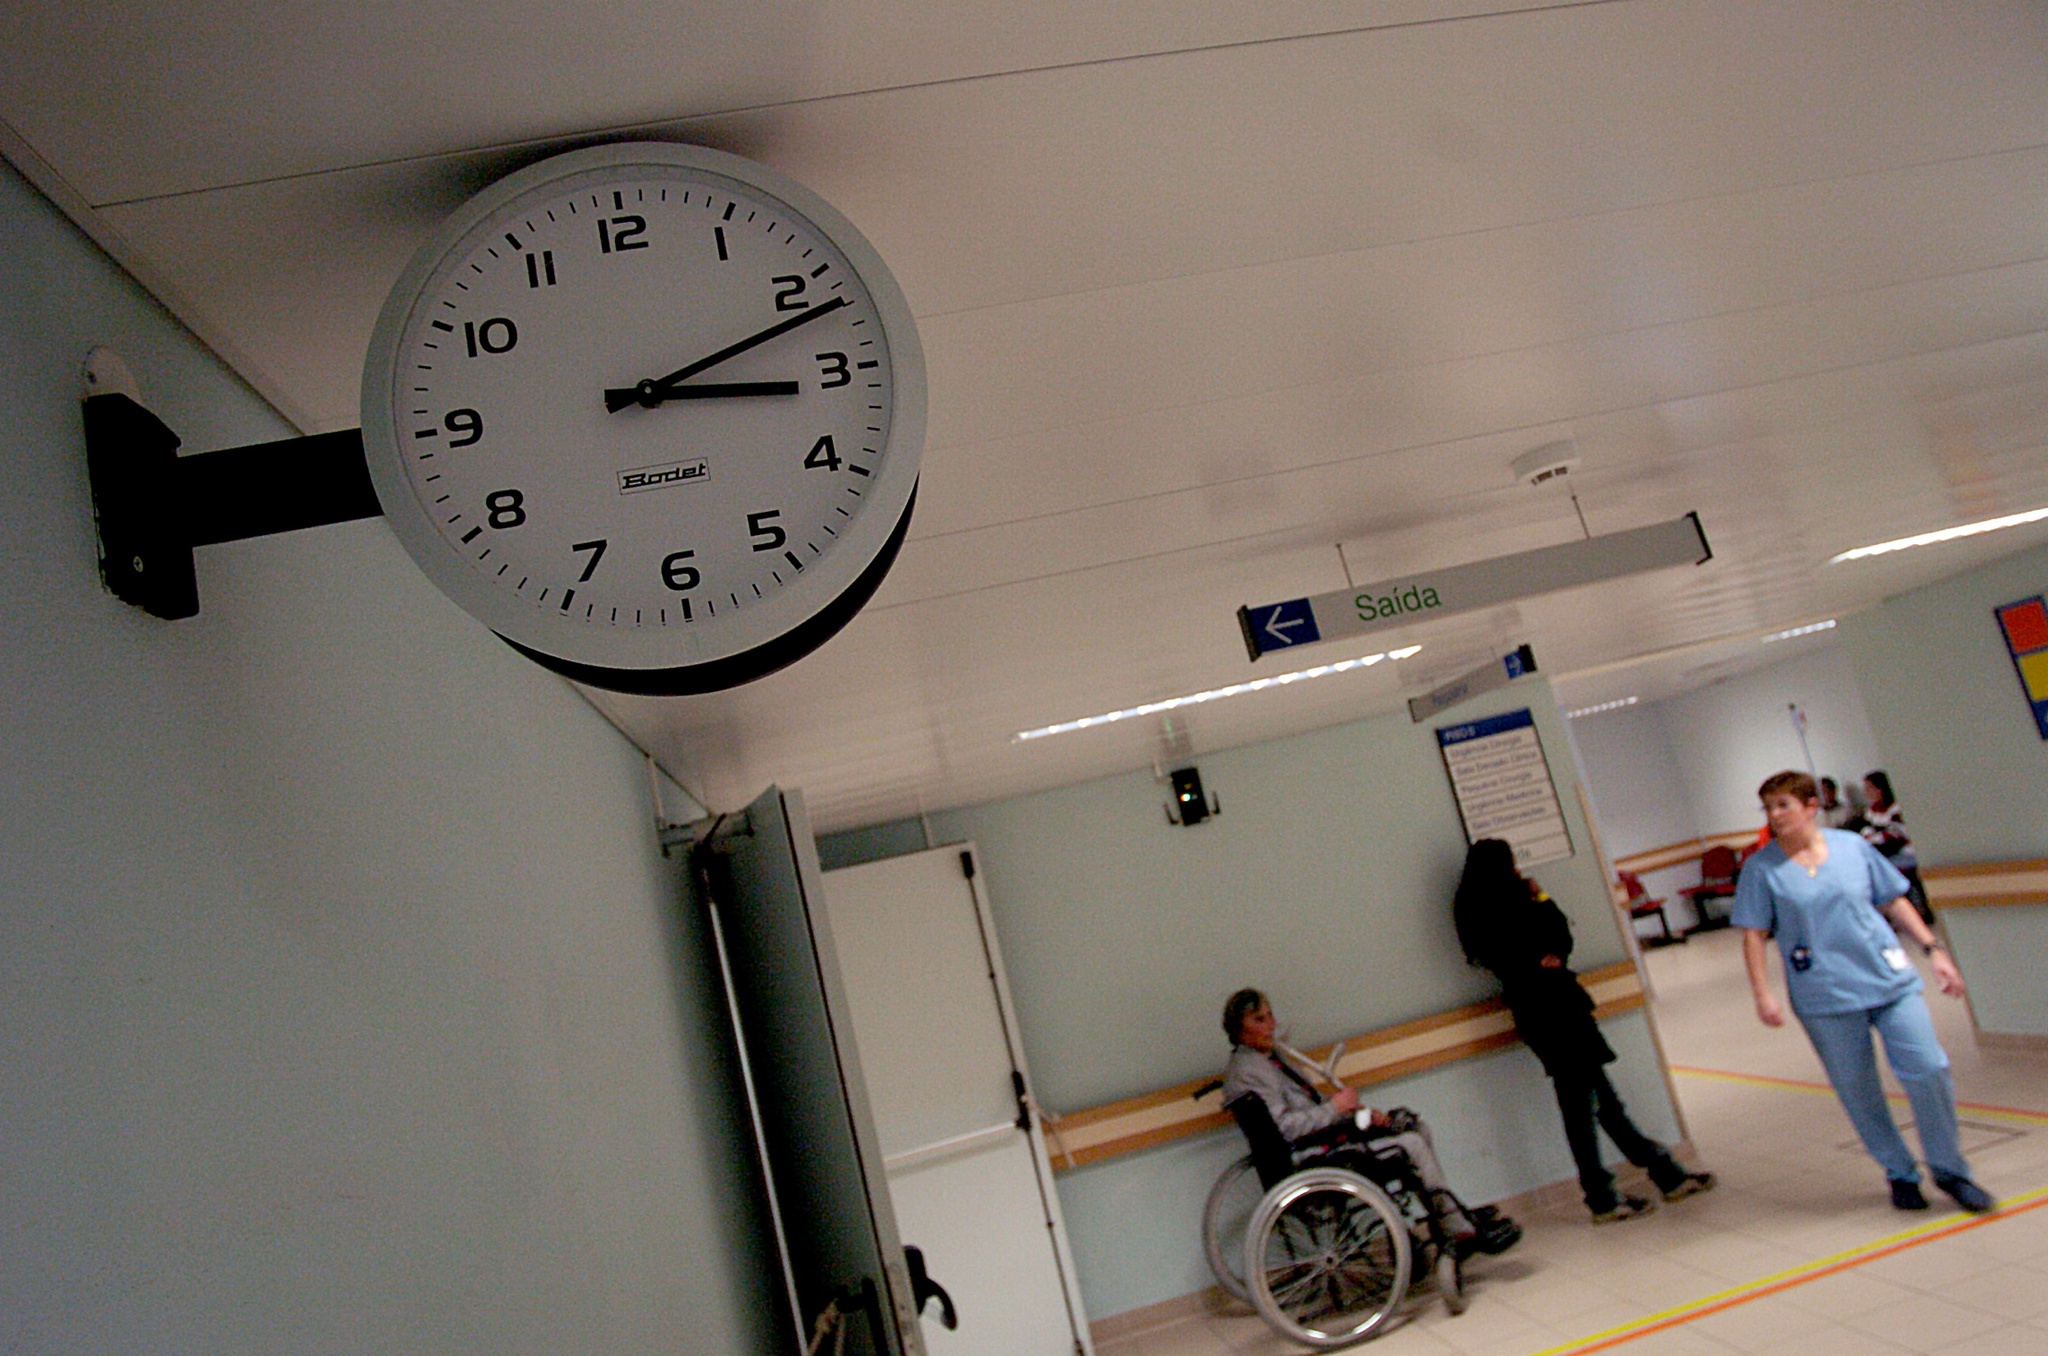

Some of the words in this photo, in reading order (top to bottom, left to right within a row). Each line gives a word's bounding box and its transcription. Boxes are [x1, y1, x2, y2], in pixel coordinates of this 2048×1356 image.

[597, 215, 650, 254] 12
[713, 226, 729, 262] 1
[526, 250, 557, 289] 11
[771, 274, 811, 313] 2
[464, 317, 518, 358] 10
[815, 351, 852, 390] 3
[443, 408, 484, 449] 9
[803, 434, 843, 473] 4
[622, 463, 707, 489] Bodet
[485, 488, 527, 530] 8
[746, 509, 788, 553] 5
[571, 538, 608, 583] 7
[660, 549, 702, 592] 6
[1355, 585, 1442, 621] Saída
